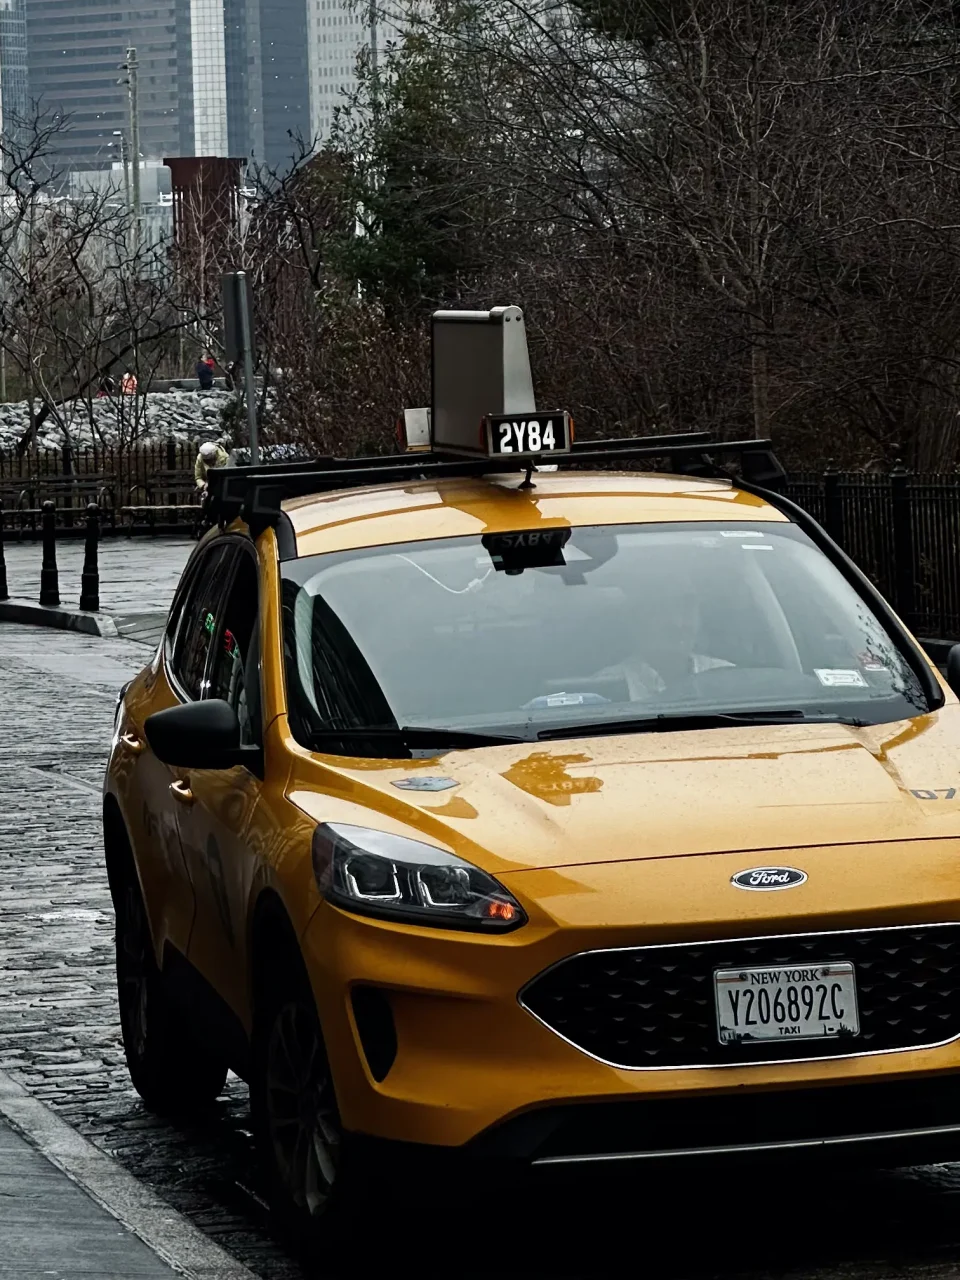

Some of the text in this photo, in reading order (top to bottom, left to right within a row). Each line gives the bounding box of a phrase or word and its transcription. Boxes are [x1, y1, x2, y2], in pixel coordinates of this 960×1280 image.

[499, 420, 555, 453] 2Y84
[749, 870, 790, 885] Ford
[751, 969, 820, 985] NEW YORK
[728, 983, 845, 1027] Y206892C
[778, 1026, 801, 1035] TAXI
